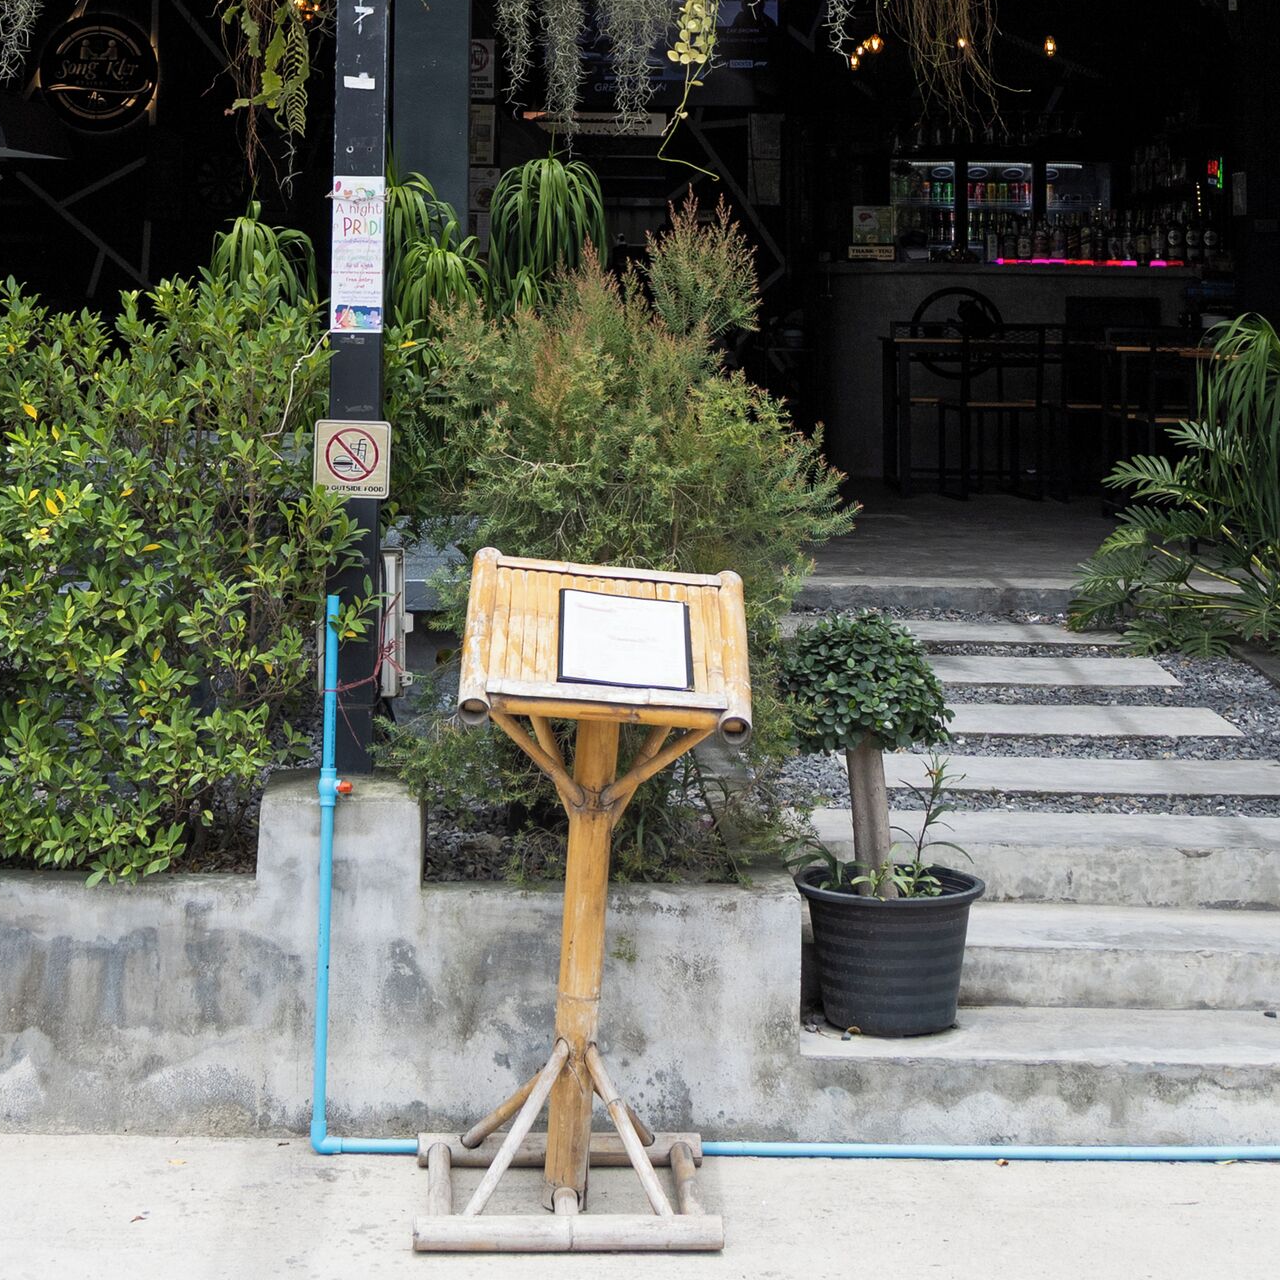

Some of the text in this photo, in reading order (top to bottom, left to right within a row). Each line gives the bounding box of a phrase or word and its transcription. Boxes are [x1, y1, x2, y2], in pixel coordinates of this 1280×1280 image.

[56, 58, 139, 80] Song Kler
[336, 202, 382, 216] A night
[344, 217, 381, 236] PRID
